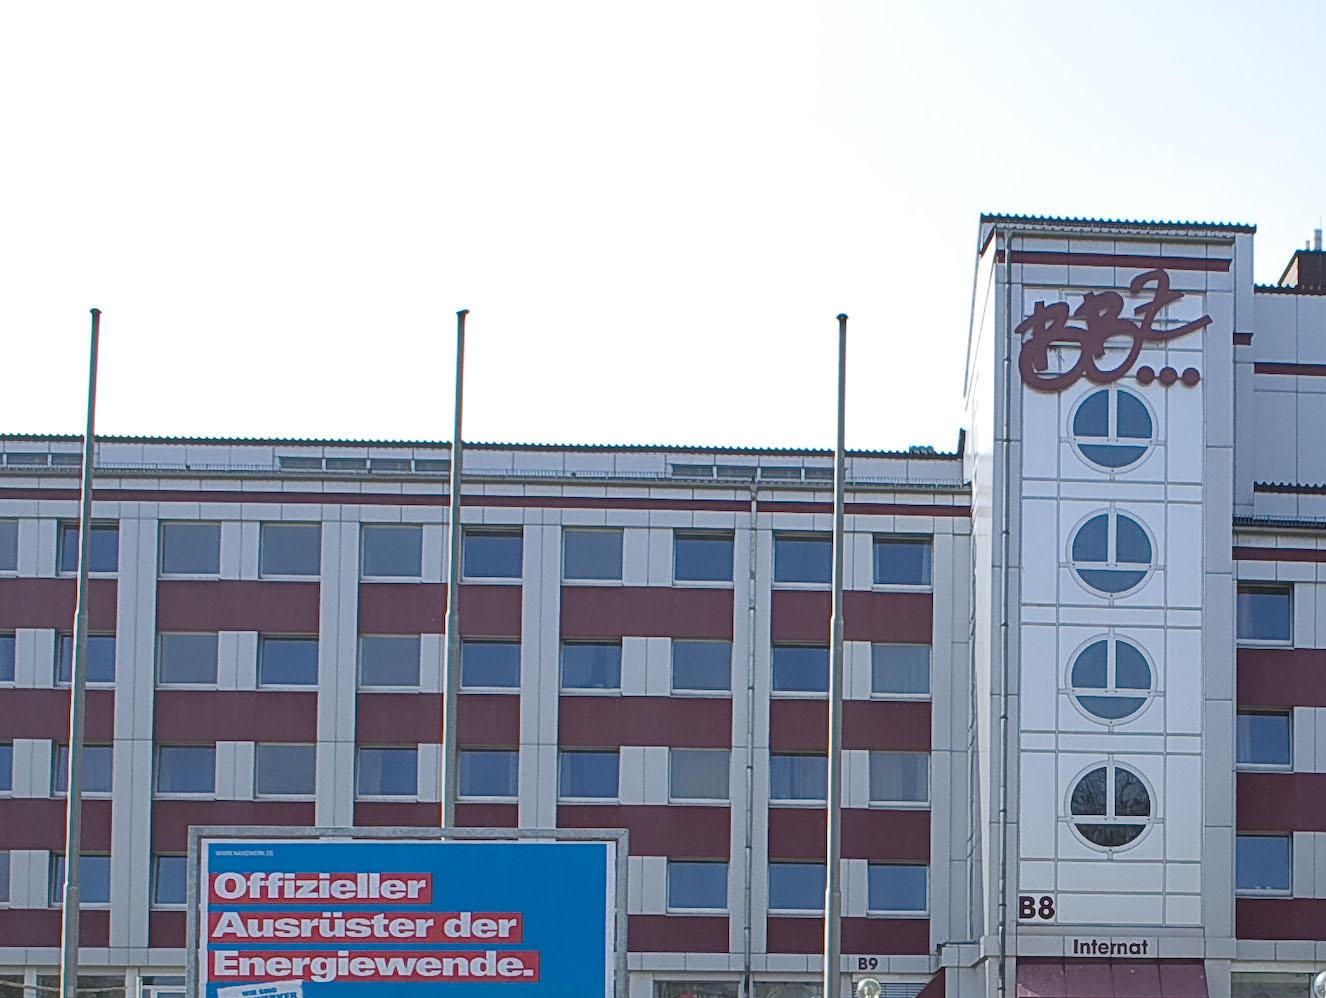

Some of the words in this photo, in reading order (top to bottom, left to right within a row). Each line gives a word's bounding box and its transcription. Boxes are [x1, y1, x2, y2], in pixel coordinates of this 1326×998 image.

[214, 872, 427, 900] Offizieller
[1018, 895, 1056, 920] B8
[211, 911, 434, 938] Ausrüster
[443, 911, 517, 938] der
[1073, 939, 1149, 956] Internat
[214, 950, 534, 982] Energiewende.
[858, 957, 878, 970] B9
